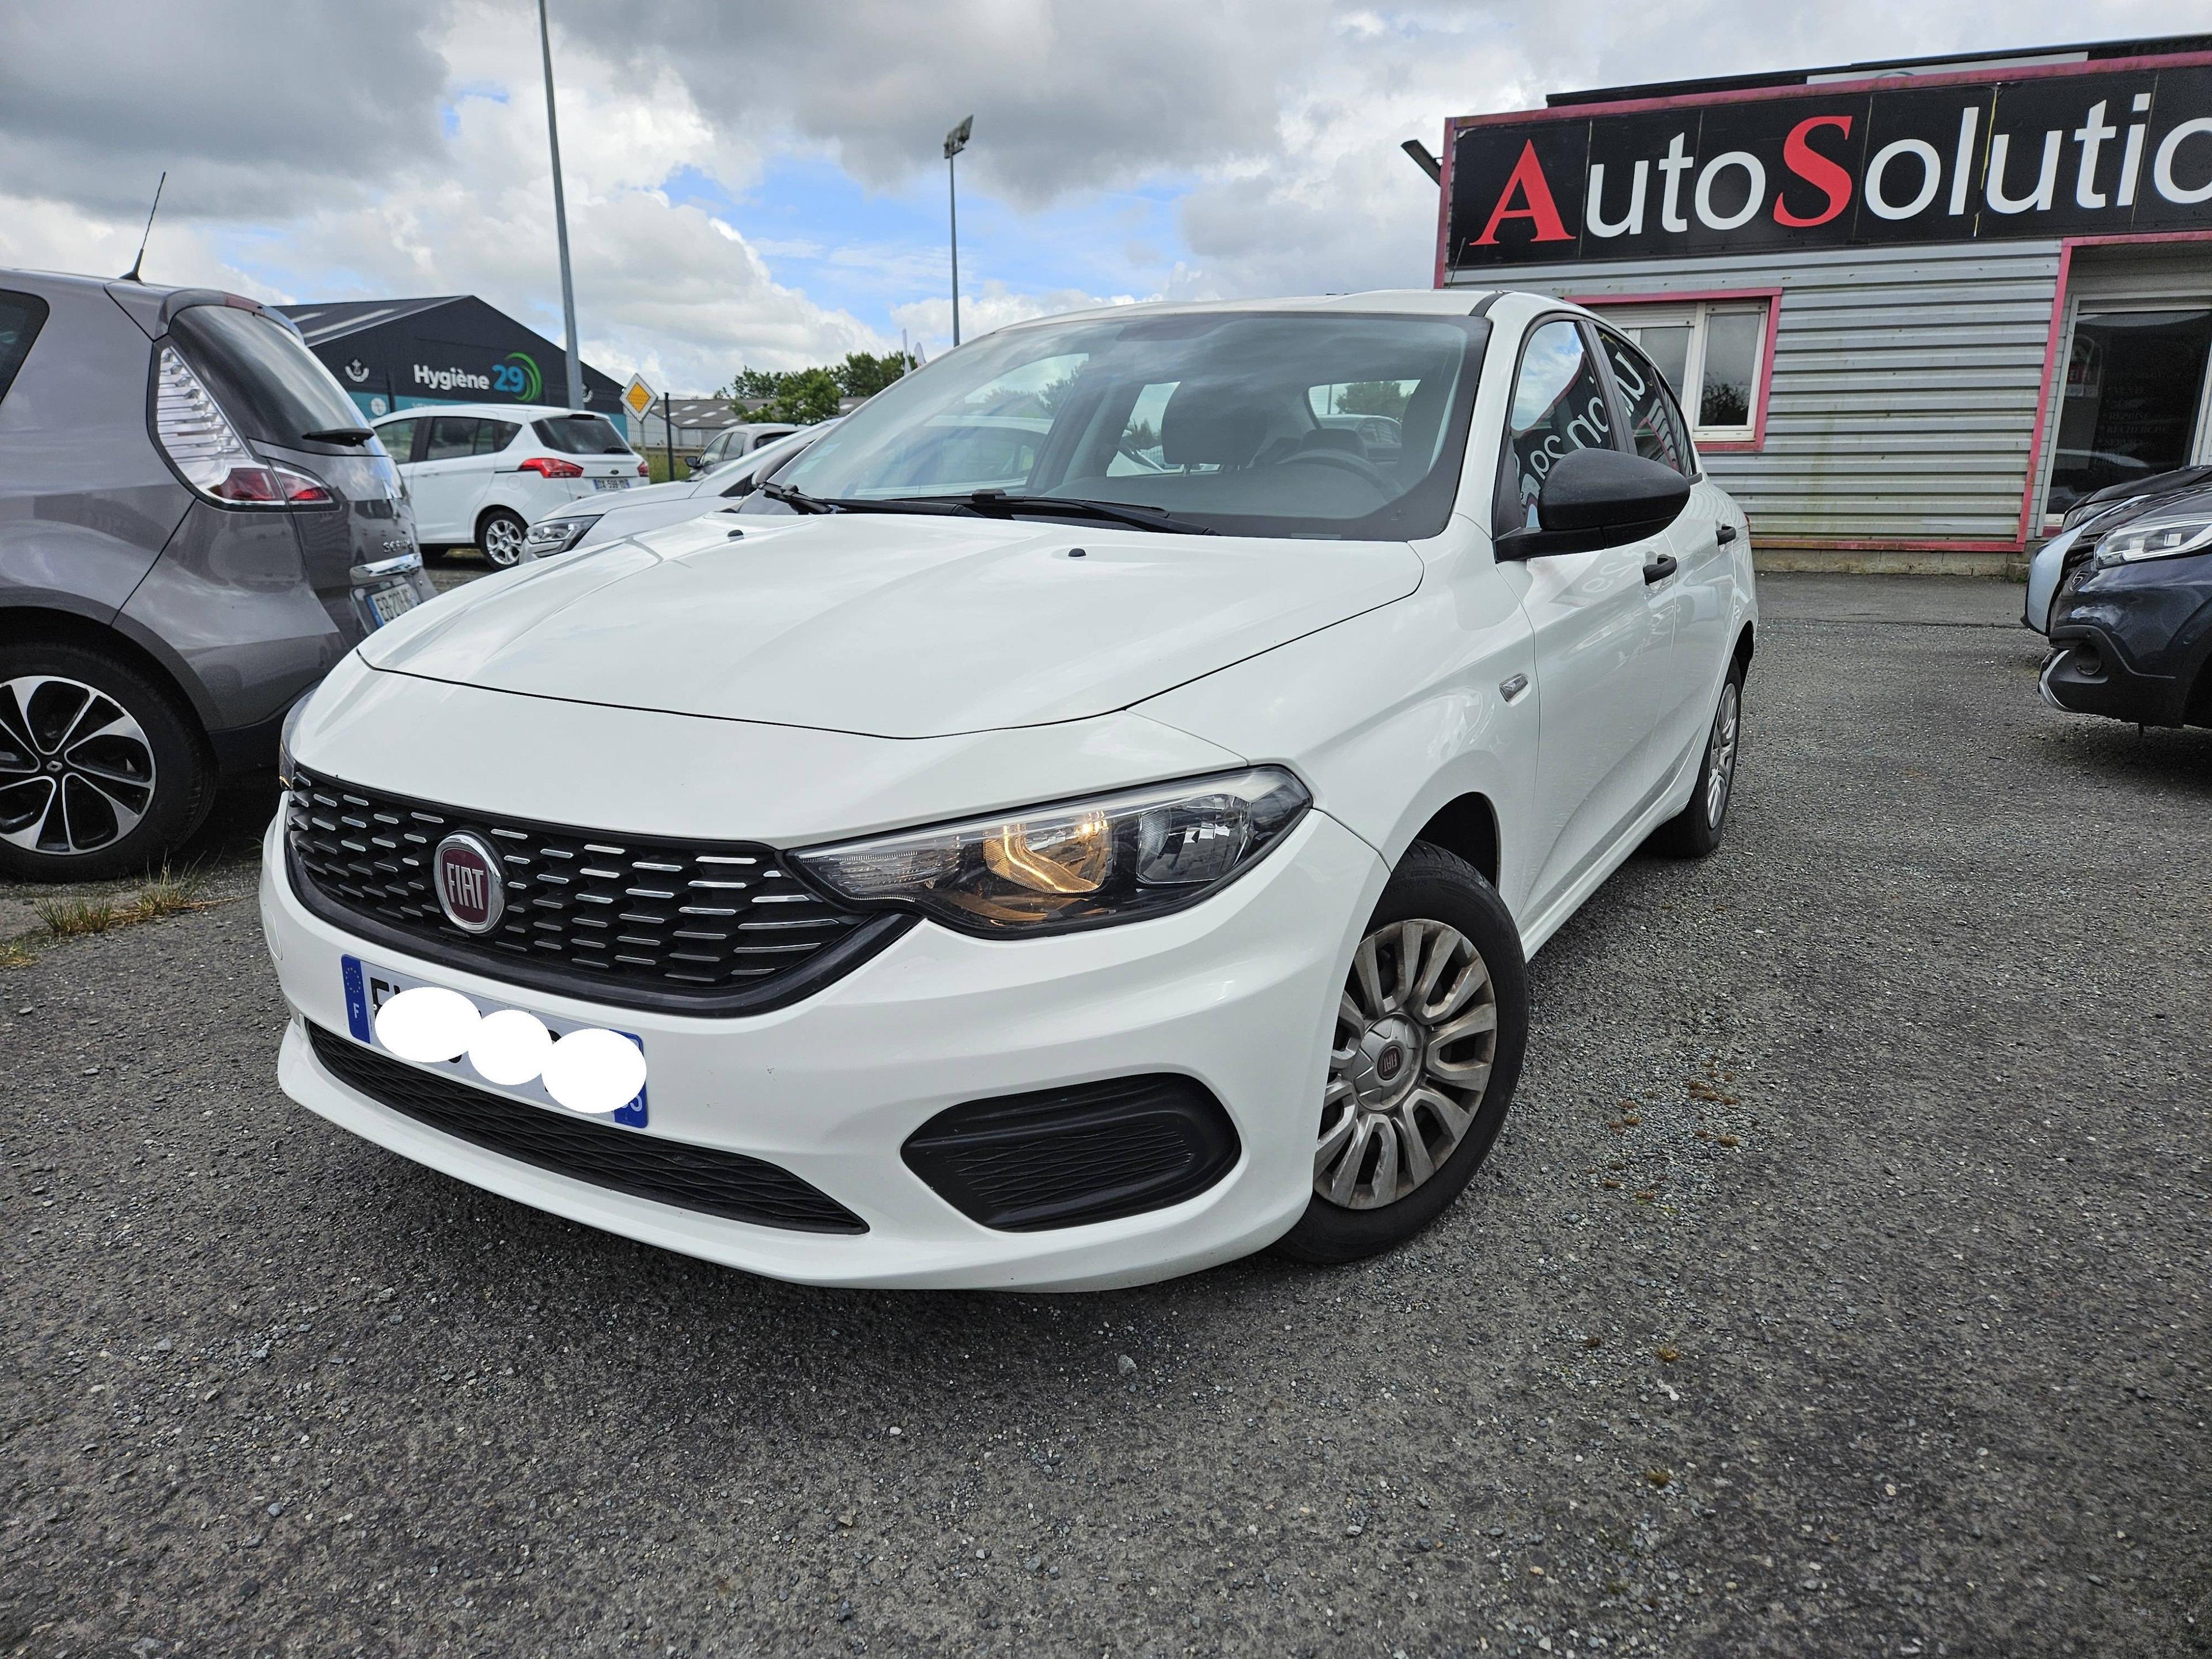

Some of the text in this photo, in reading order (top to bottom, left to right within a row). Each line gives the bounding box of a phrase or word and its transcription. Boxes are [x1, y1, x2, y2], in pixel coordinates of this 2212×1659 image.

[413, 363, 525, 393] Hygiène 29
[446, 862, 485, 911] FIAT
[353, 1002, 360, 1019] F
[1382, 1052, 1397, 1072] FIAT
